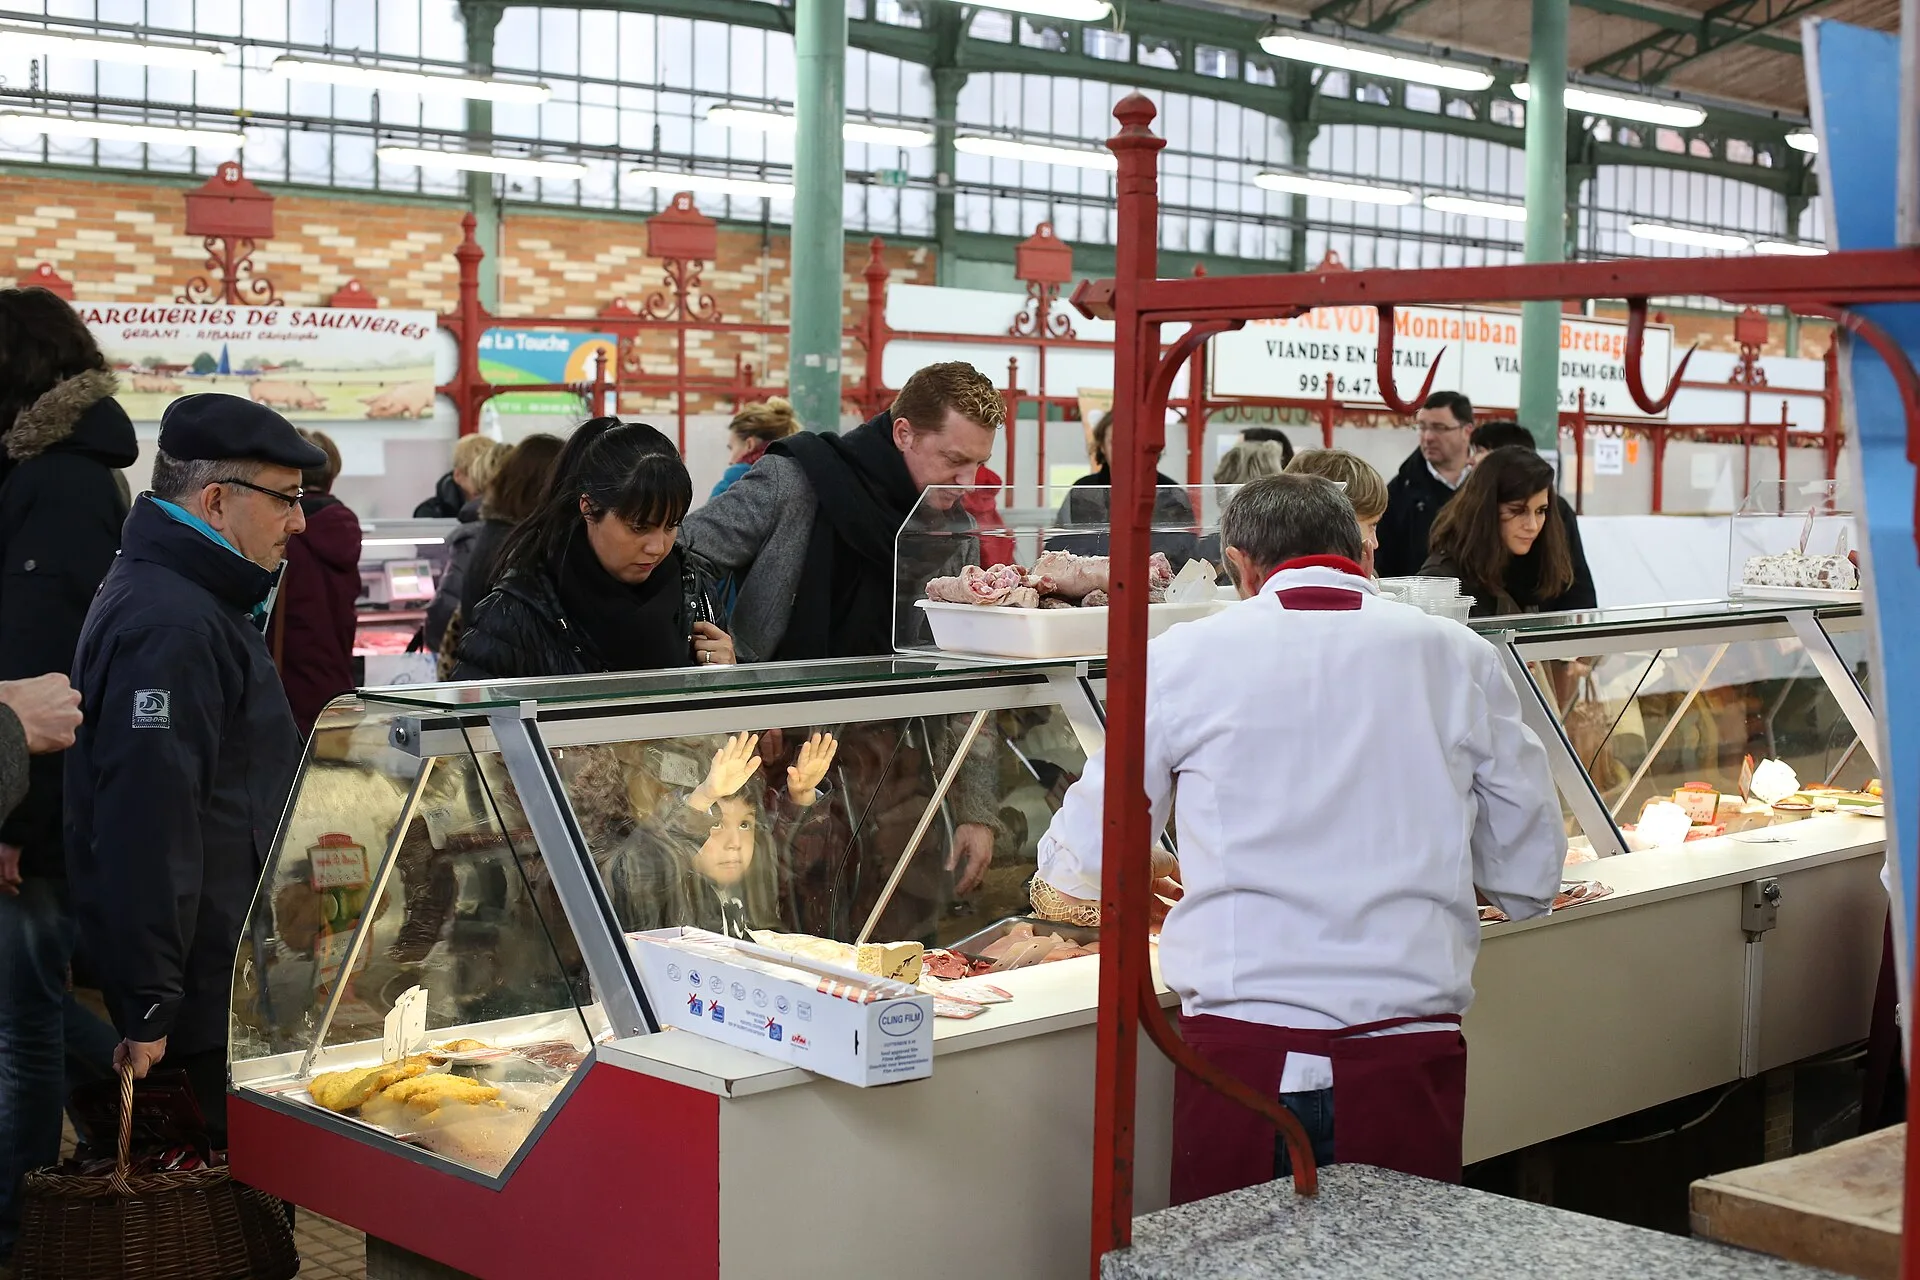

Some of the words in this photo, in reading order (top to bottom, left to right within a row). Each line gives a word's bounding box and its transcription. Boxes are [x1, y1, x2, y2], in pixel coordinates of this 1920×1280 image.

[78, 308, 236, 326] ARCUTERIES
[246, 309, 279, 326] DE
[289, 311, 430, 340] SAULNIERES
[495, 332, 515, 351] La
[515, 333, 571, 352] Touche
[1393, 311, 1517, 345] Montauban
[1560, 325, 1645, 360] Bretag
[1266, 340, 1340, 362] VIANDES
[1346, 346, 1367, 364] EN
[1373, 348, 1430, 368] TAIL
[1561, 361, 1626, 381] DEMI-GRO
[1299, 374, 1398, 396] 99.6.47.
[882, 1015, 903, 1025] CLING
[904, 1012, 921, 1023] FILM
